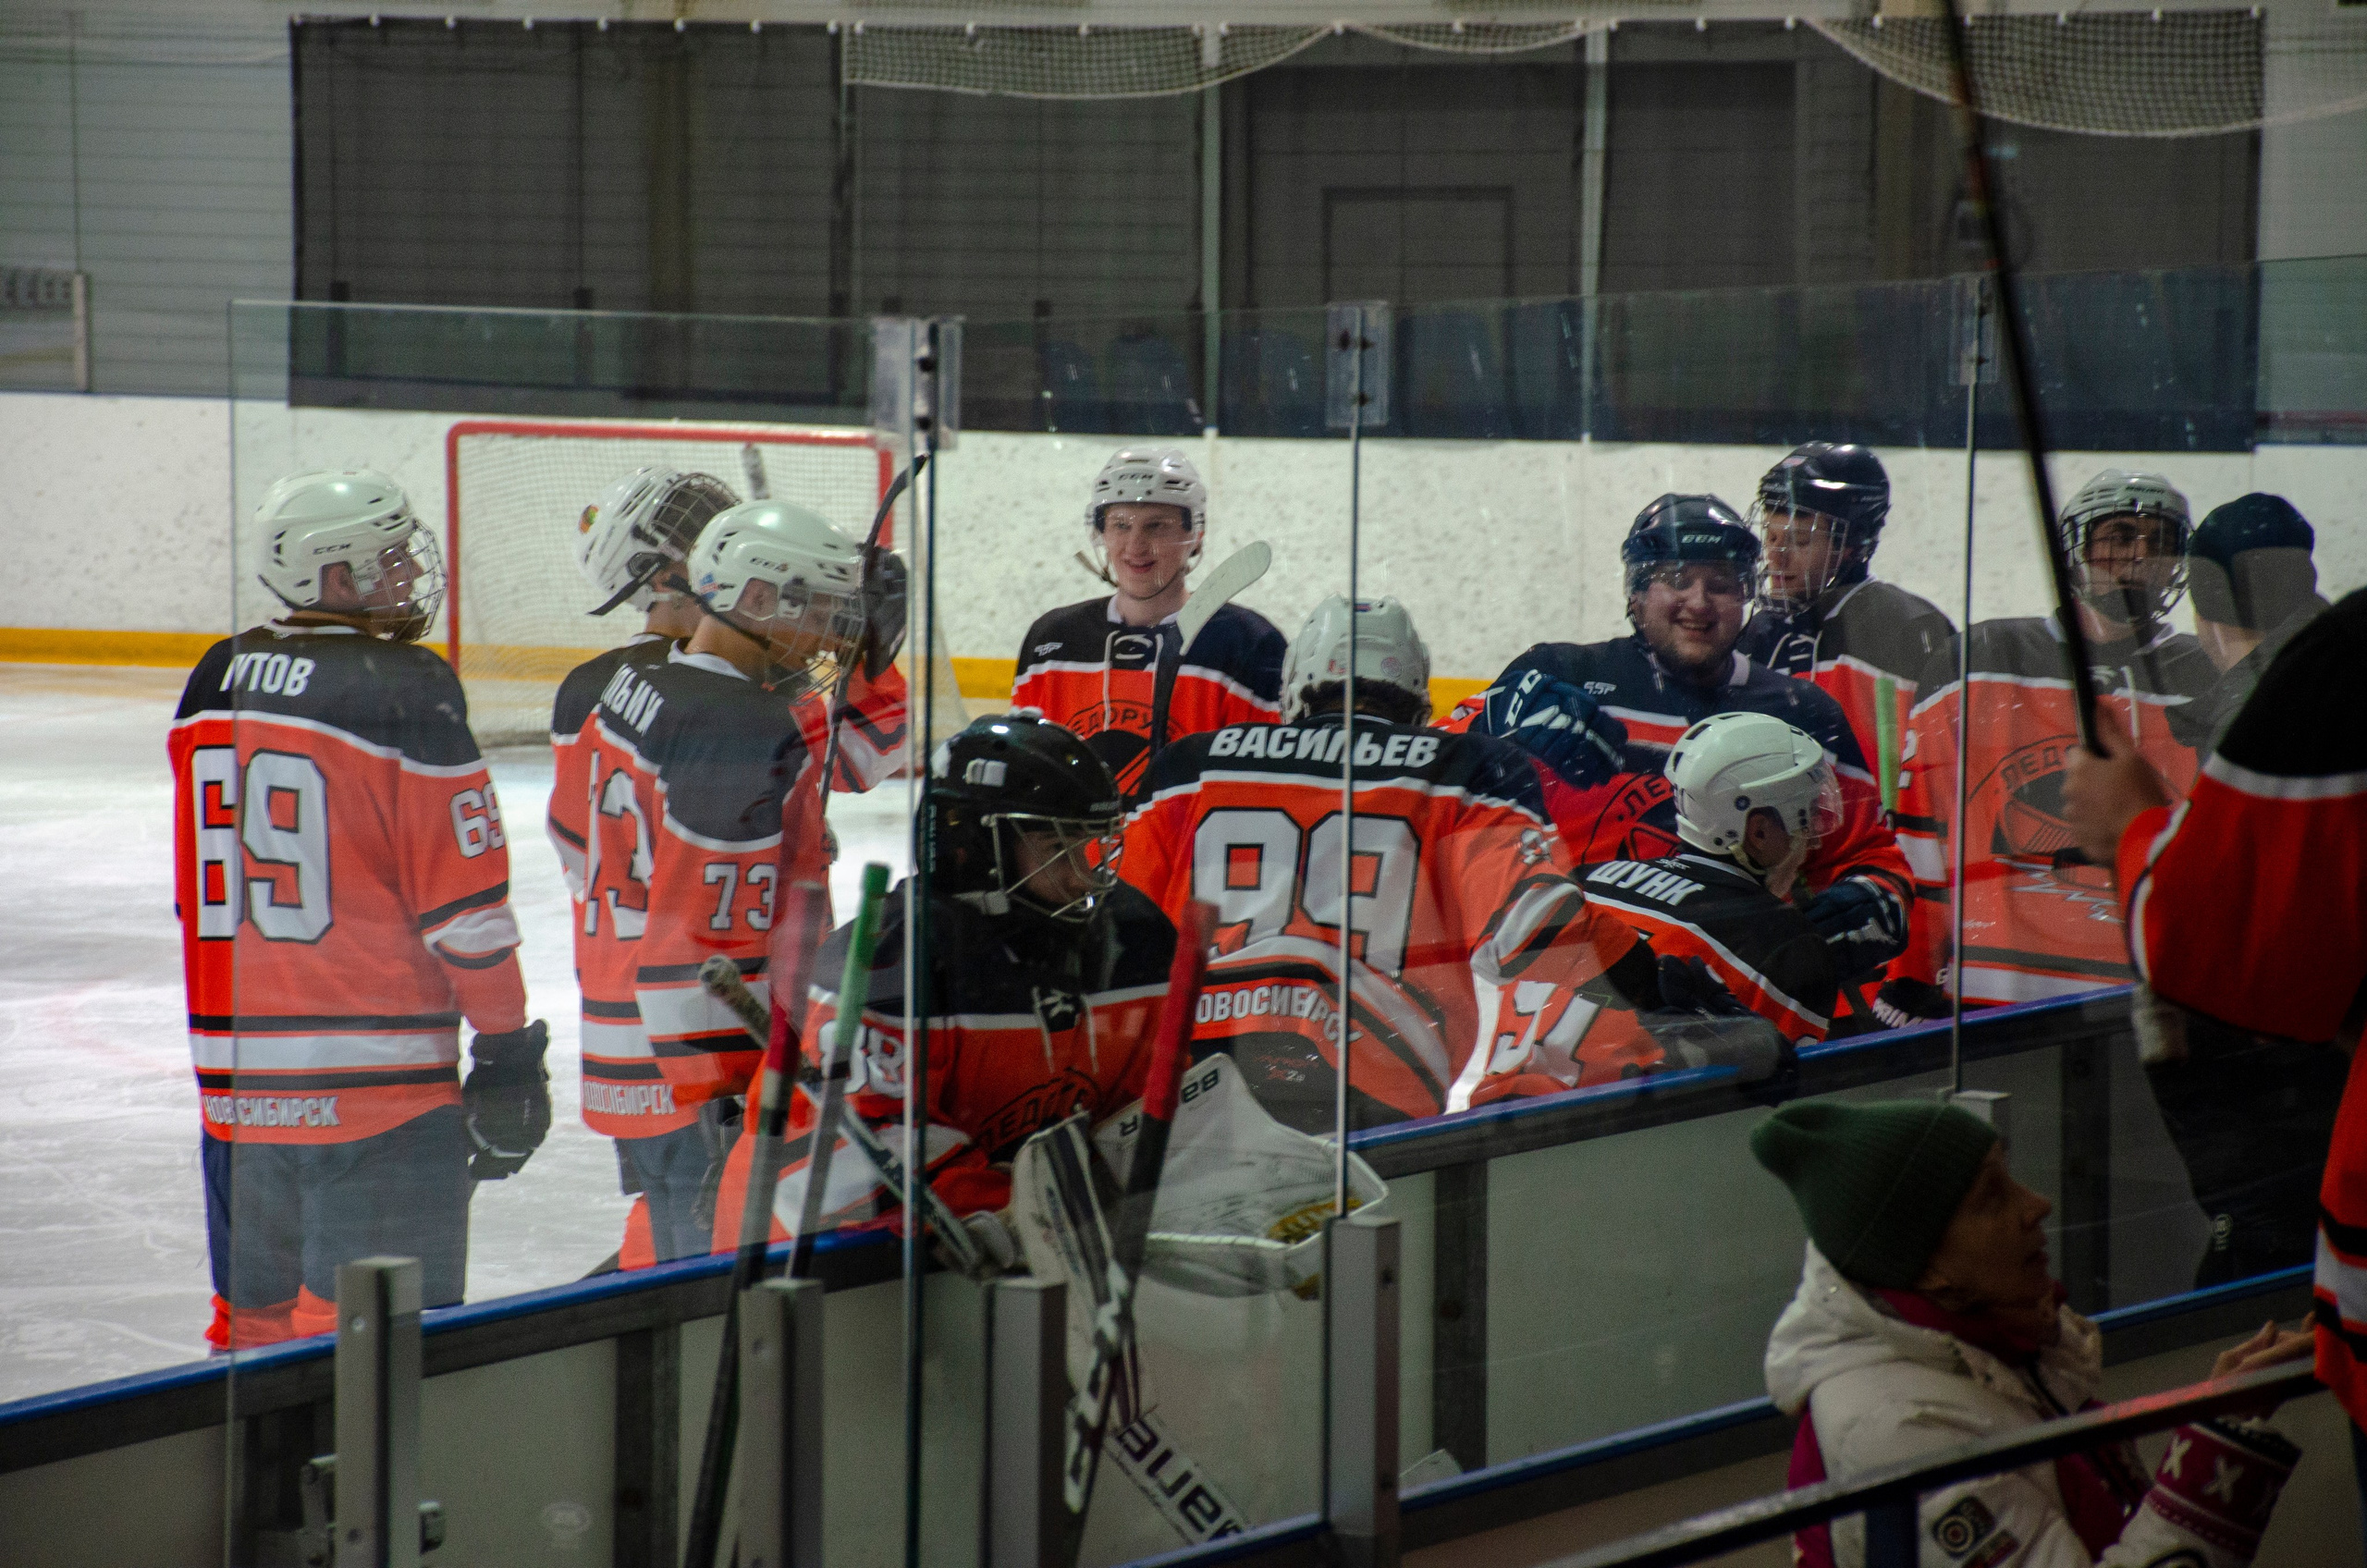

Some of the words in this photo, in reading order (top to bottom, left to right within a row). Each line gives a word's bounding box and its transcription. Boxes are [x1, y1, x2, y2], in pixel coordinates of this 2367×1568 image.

[1681, 534, 1723, 544] CCM
[1208, 726, 1441, 768] ВАСИЛЬЕВ
[191, 744, 332, 945] 69
[449, 781, 505, 859] 69
[703, 862, 779, 931] 73
[1194, 807, 1421, 977] 99
[1586, 860, 1706, 906] ШУНК
[1195, 985, 1364, 1048] ОВОСИБИРС
[202, 1094, 341, 1127] НОВСИБИРСК
